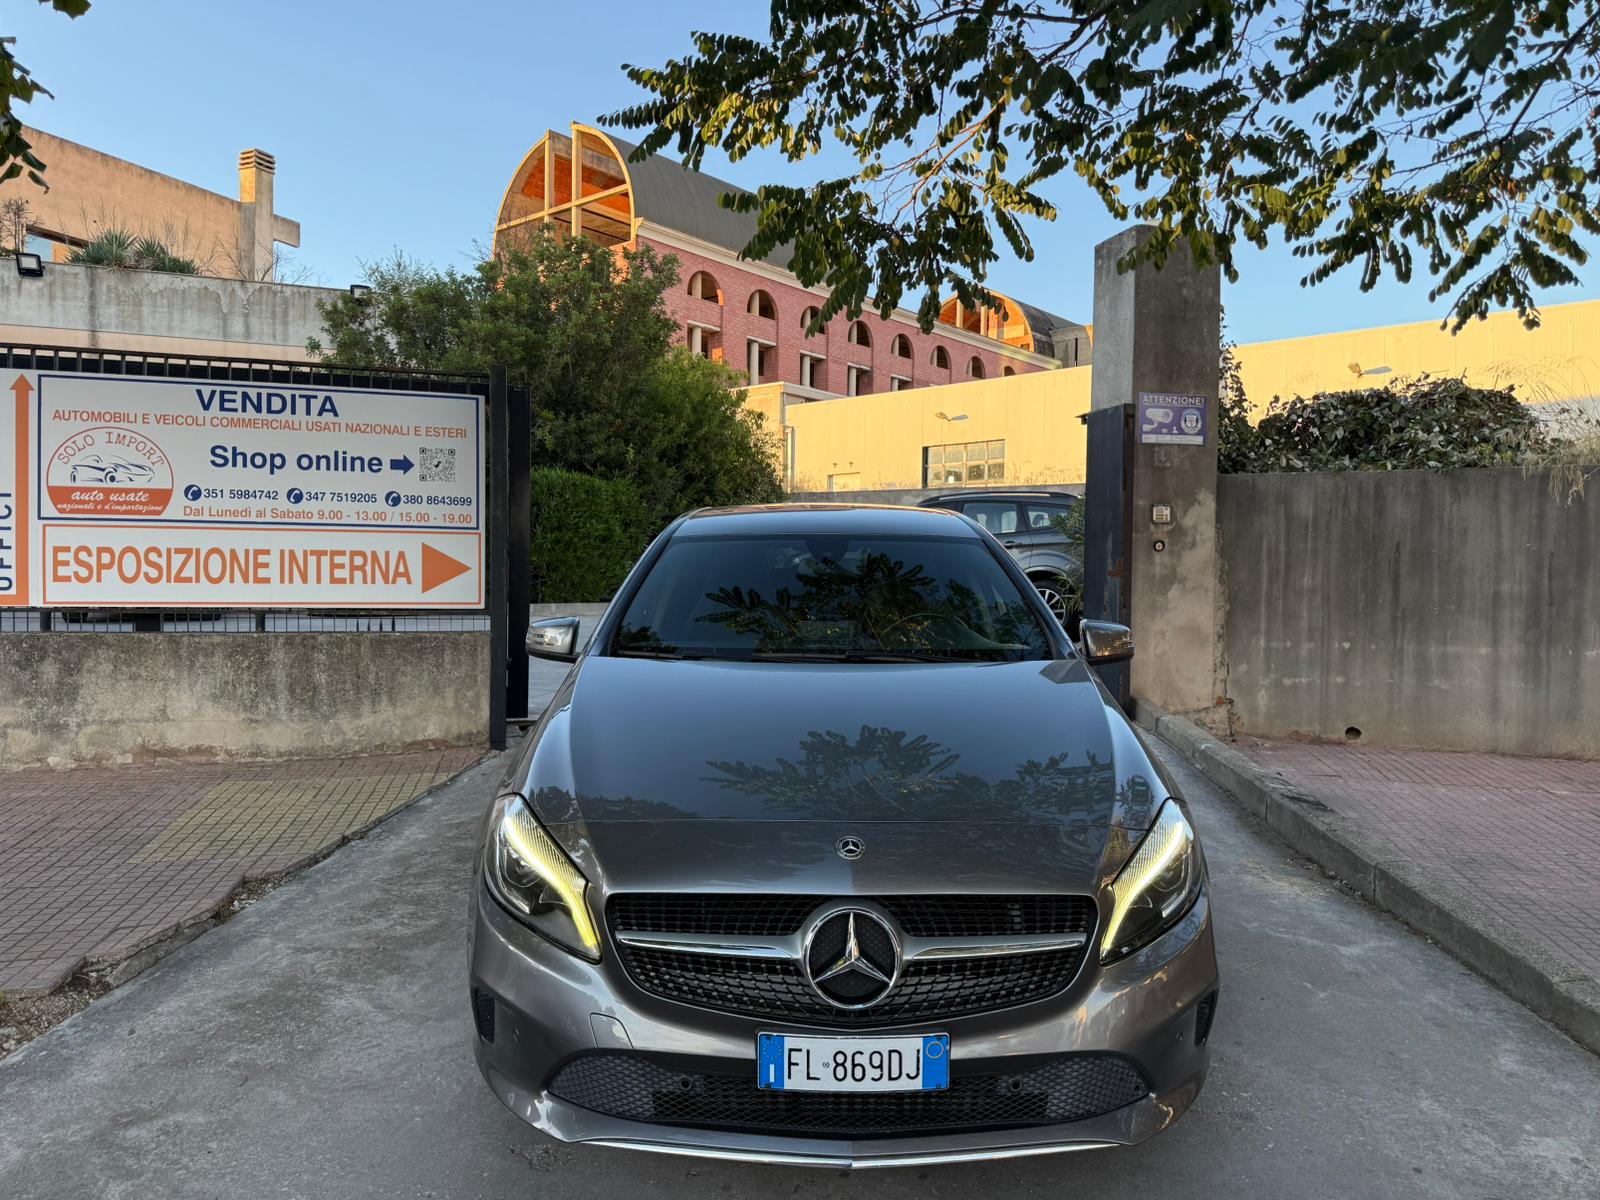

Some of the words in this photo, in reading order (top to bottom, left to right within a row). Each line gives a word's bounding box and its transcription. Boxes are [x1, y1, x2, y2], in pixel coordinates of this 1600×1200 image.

[195, 389, 339, 417] VENDITA
[1143, 395, 1205, 406] ATTENZIONE!
[52, 409, 138, 424] AUTOMOBILI
[142, 413, 150, 424] E
[154, 414, 206, 427] VEICOLI
[210, 416, 301, 431] COMMERCIALI
[306, 421, 341, 433] USATI
[345, 423, 410, 436] NAZIONALI
[414, 426, 421, 436] E
[425, 427, 467, 439] ESTERI
[57, 434, 95, 465] SOLO
[105, 431, 164, 467] IMPORT
[209, 445, 286, 475] Shop
[296, 450, 383, 473] online
[71, 490, 105, 501] auto
[109, 491, 150, 502] usate
[204, 488, 224, 499] 351
[229, 489, 279, 500] 5984742
[305, 491, 326, 502] 347
[330, 492, 377, 503] 7519205
[403, 494, 423, 505] 380
[426, 495, 472, 507] 8643699
[56, 502, 95, 512] nazionali
[183, 505, 204, 517] Dal
[208, 506, 252, 518] Lunedì
[255, 508, 266, 519] al
[270, 508, 313, 520] Sabato
[317, 509, 343, 521] 9.00
[355, 511, 387, 522] 13.00
[399, 512, 430, 523] 15.00
[442, 513, 472, 524] 19.00
[52, 545, 271, 584] ESPOSIZIONE
[279, 549, 413, 585] INTERNA
[787, 1047, 821, 1081] FL
[832, 1048, 921, 1083] 869DJ
